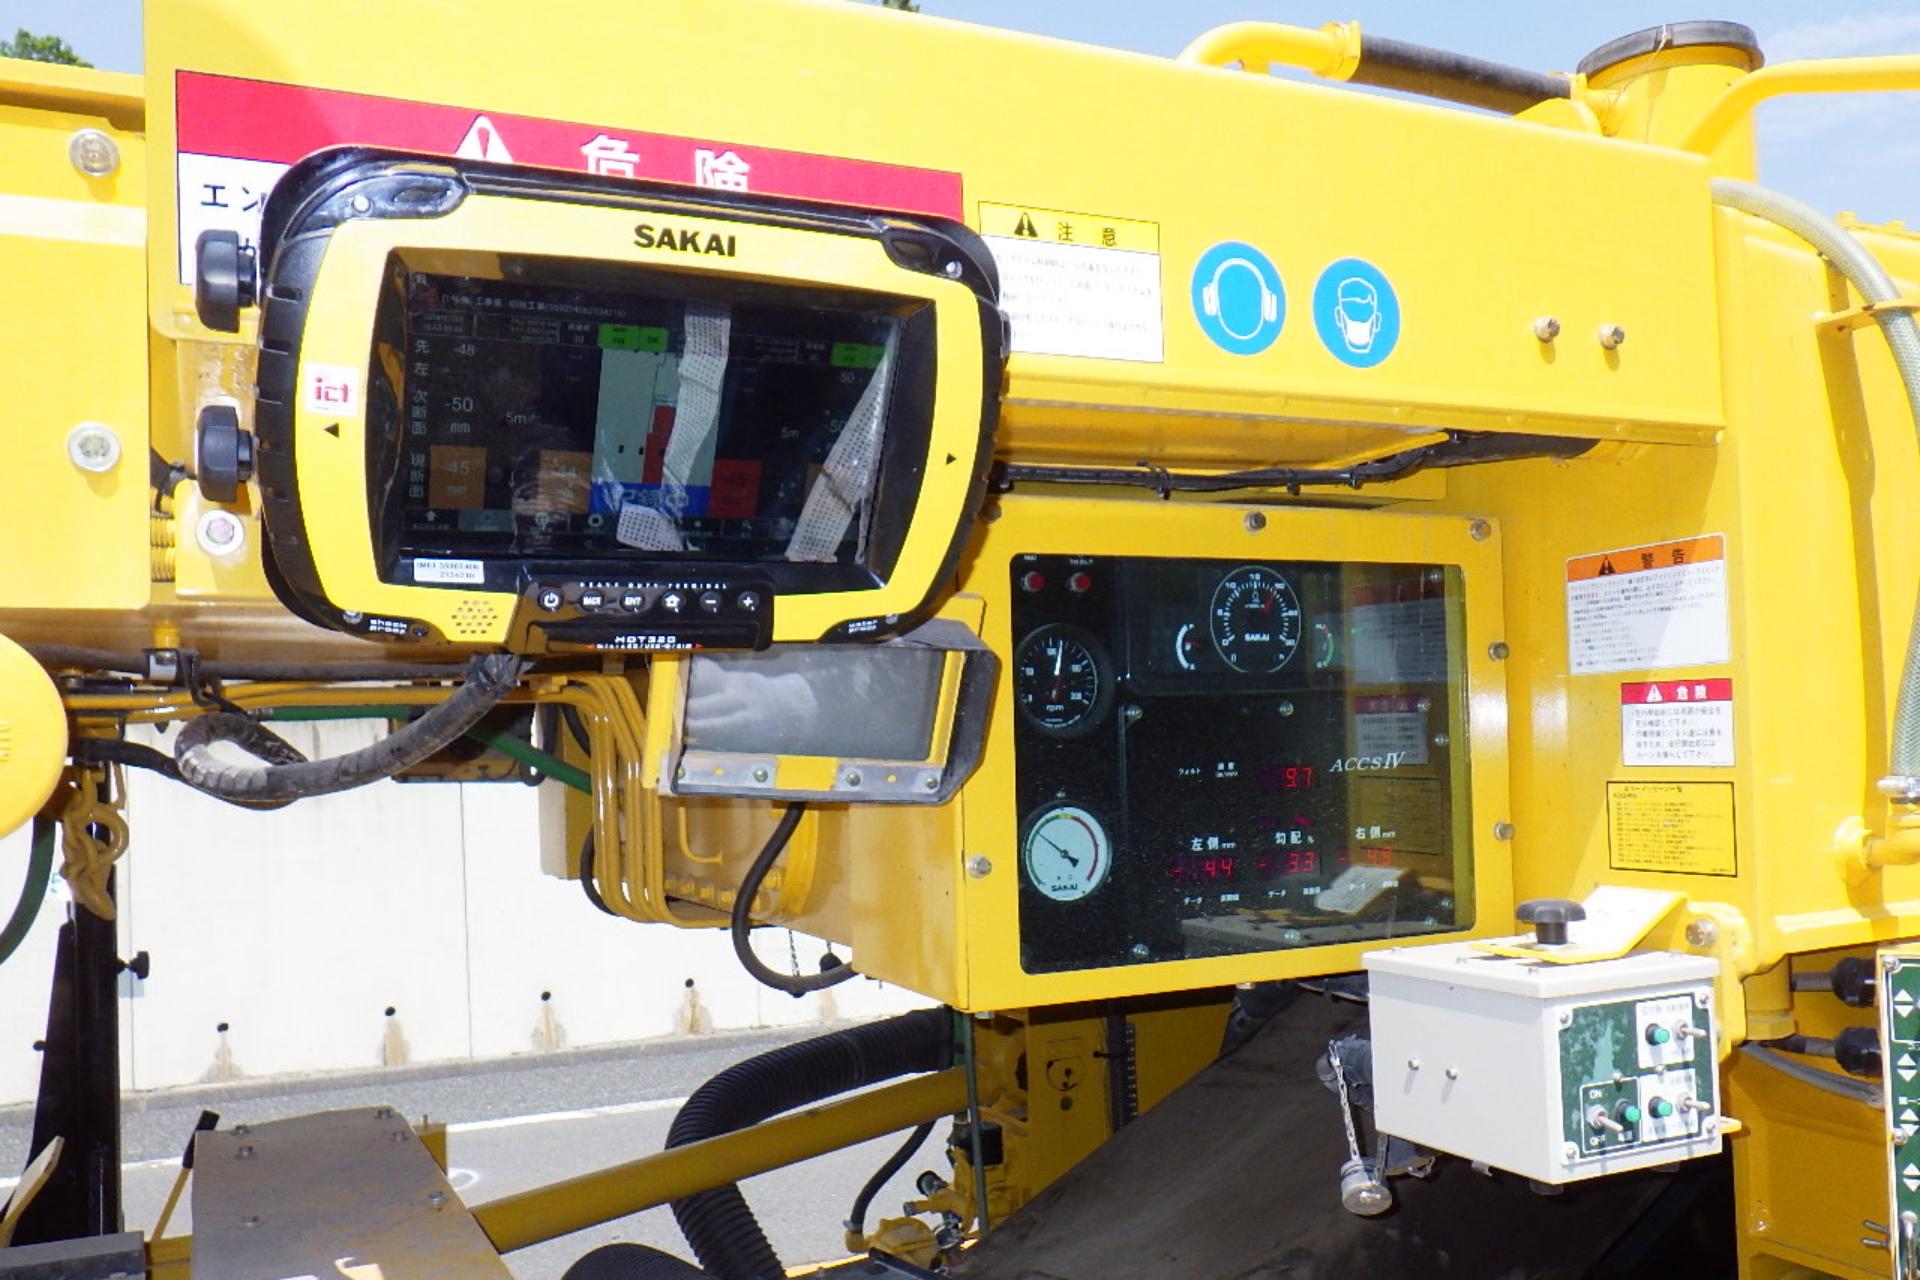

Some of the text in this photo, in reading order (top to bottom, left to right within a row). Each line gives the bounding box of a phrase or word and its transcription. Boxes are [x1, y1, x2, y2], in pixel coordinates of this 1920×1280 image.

[633, 224, 736, 258] SAKAI
[444, 396, 474, 413] -50
[582, 596, 602, 606] BACK
[624, 596, 641, 606] ENT
[1244, 632, 1270, 642] SAKAI
[1051, 883, 1078, 892] SAKAI
[1589, 1088, 1603, 1099] ON
